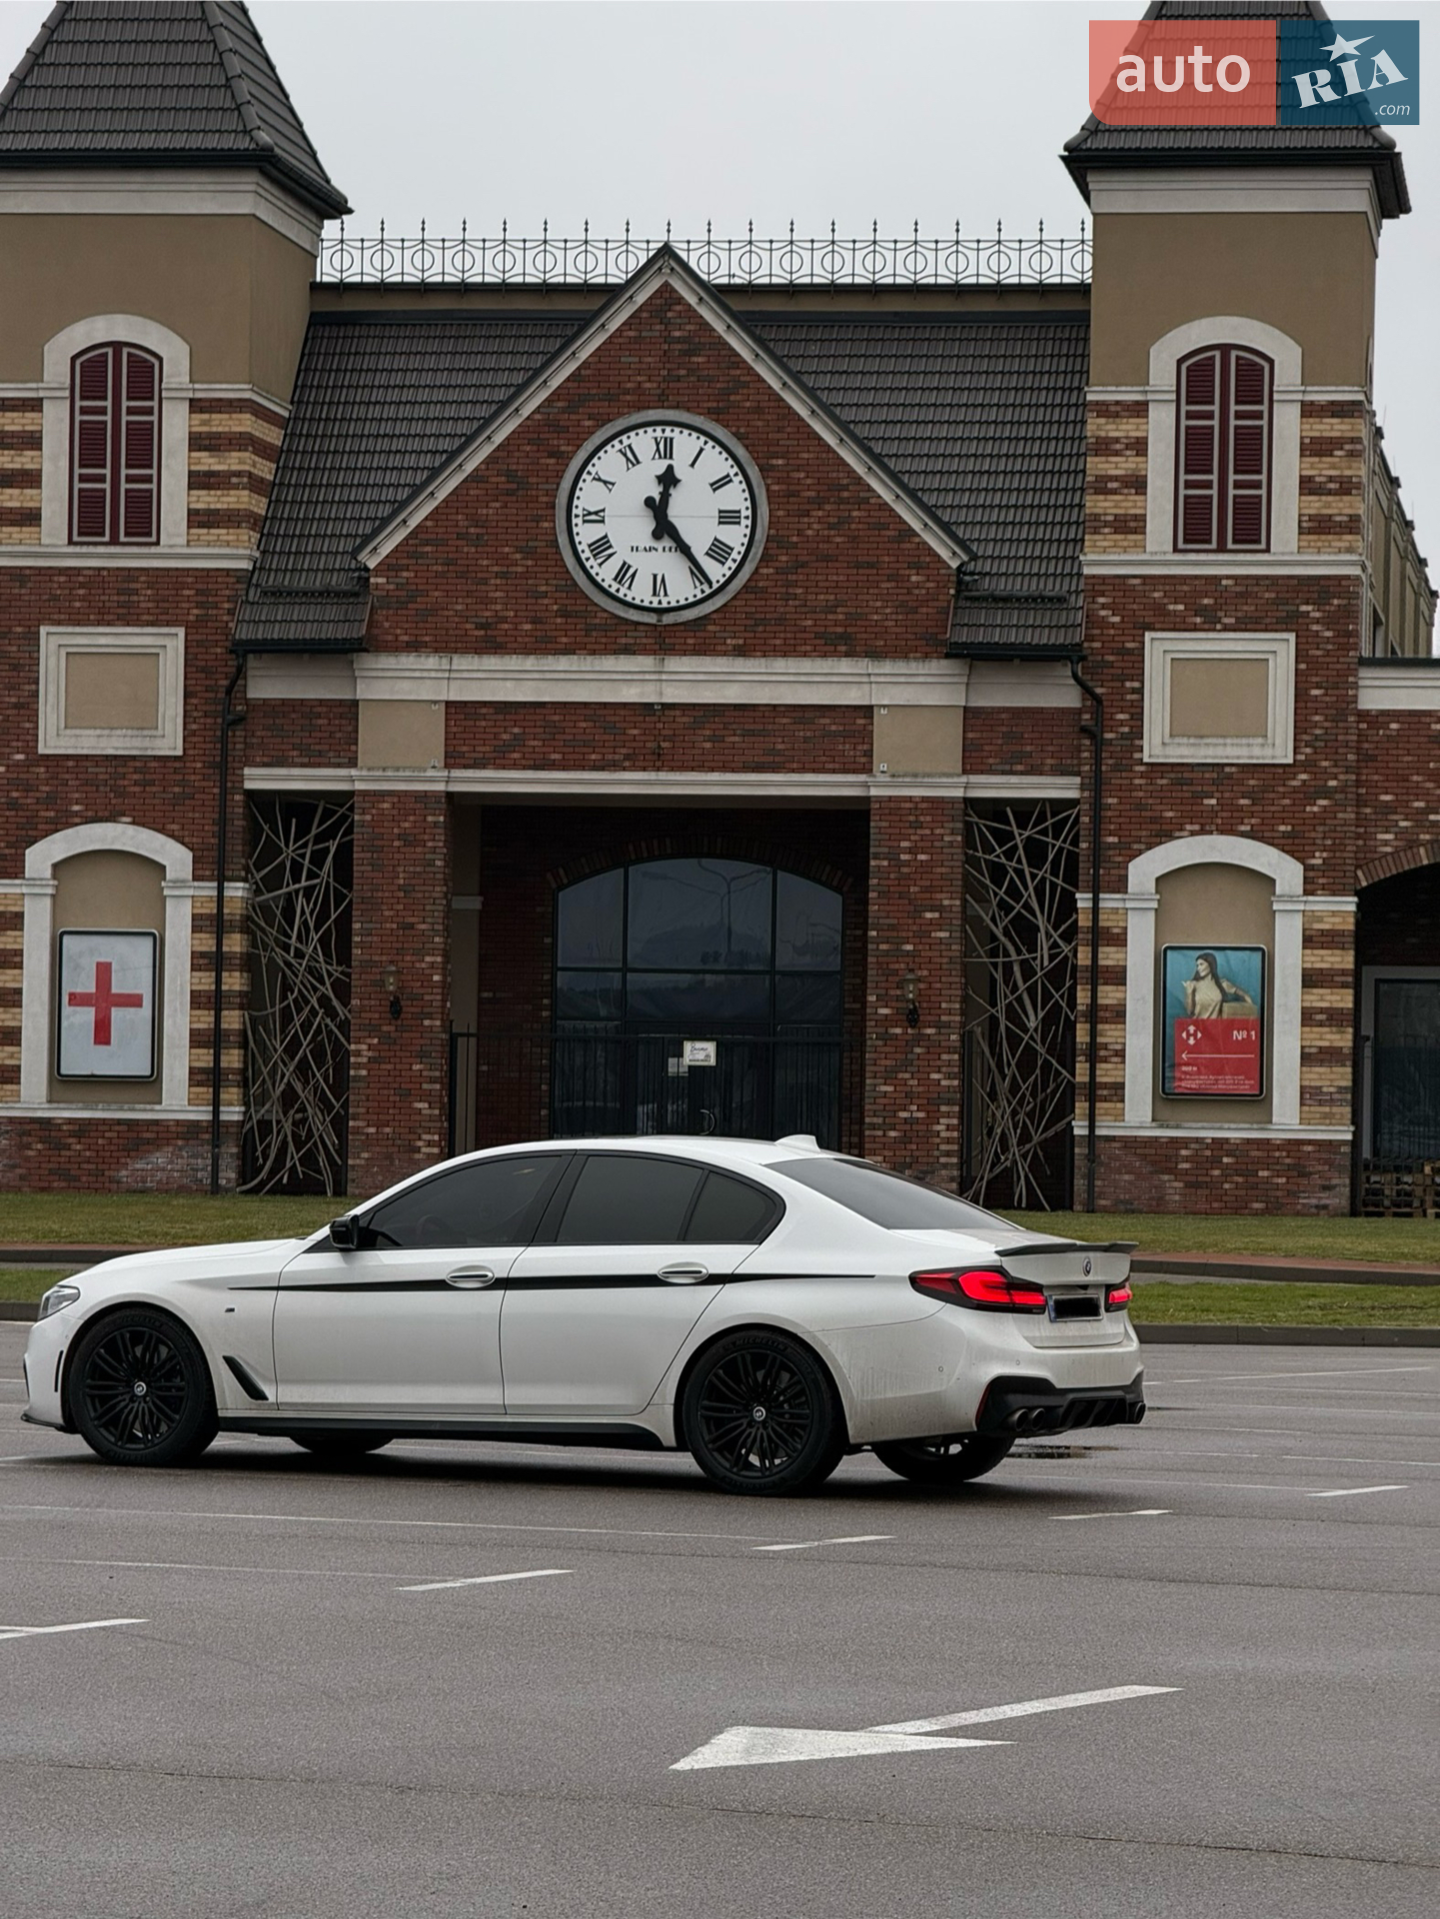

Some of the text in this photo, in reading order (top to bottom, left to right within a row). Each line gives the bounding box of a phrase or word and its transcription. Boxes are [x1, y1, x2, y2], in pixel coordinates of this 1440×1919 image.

[616, 443, 643, 472] XI
[651, 436, 675, 461] XII
[688, 446, 705, 469] I
[590, 471, 617, 493] X
[708, 472, 735, 494] II
[582, 507, 606, 526] IX
[717, 508, 742, 527] III
[586, 532, 618, 568] VIII
[630, 545, 659, 553] TRAIN
[703, 536, 735, 567] IIII
[612, 559, 639, 591] VII
[651, 573, 669, 598] VI
[735, 1335, 783, 1350] MICHELIN
